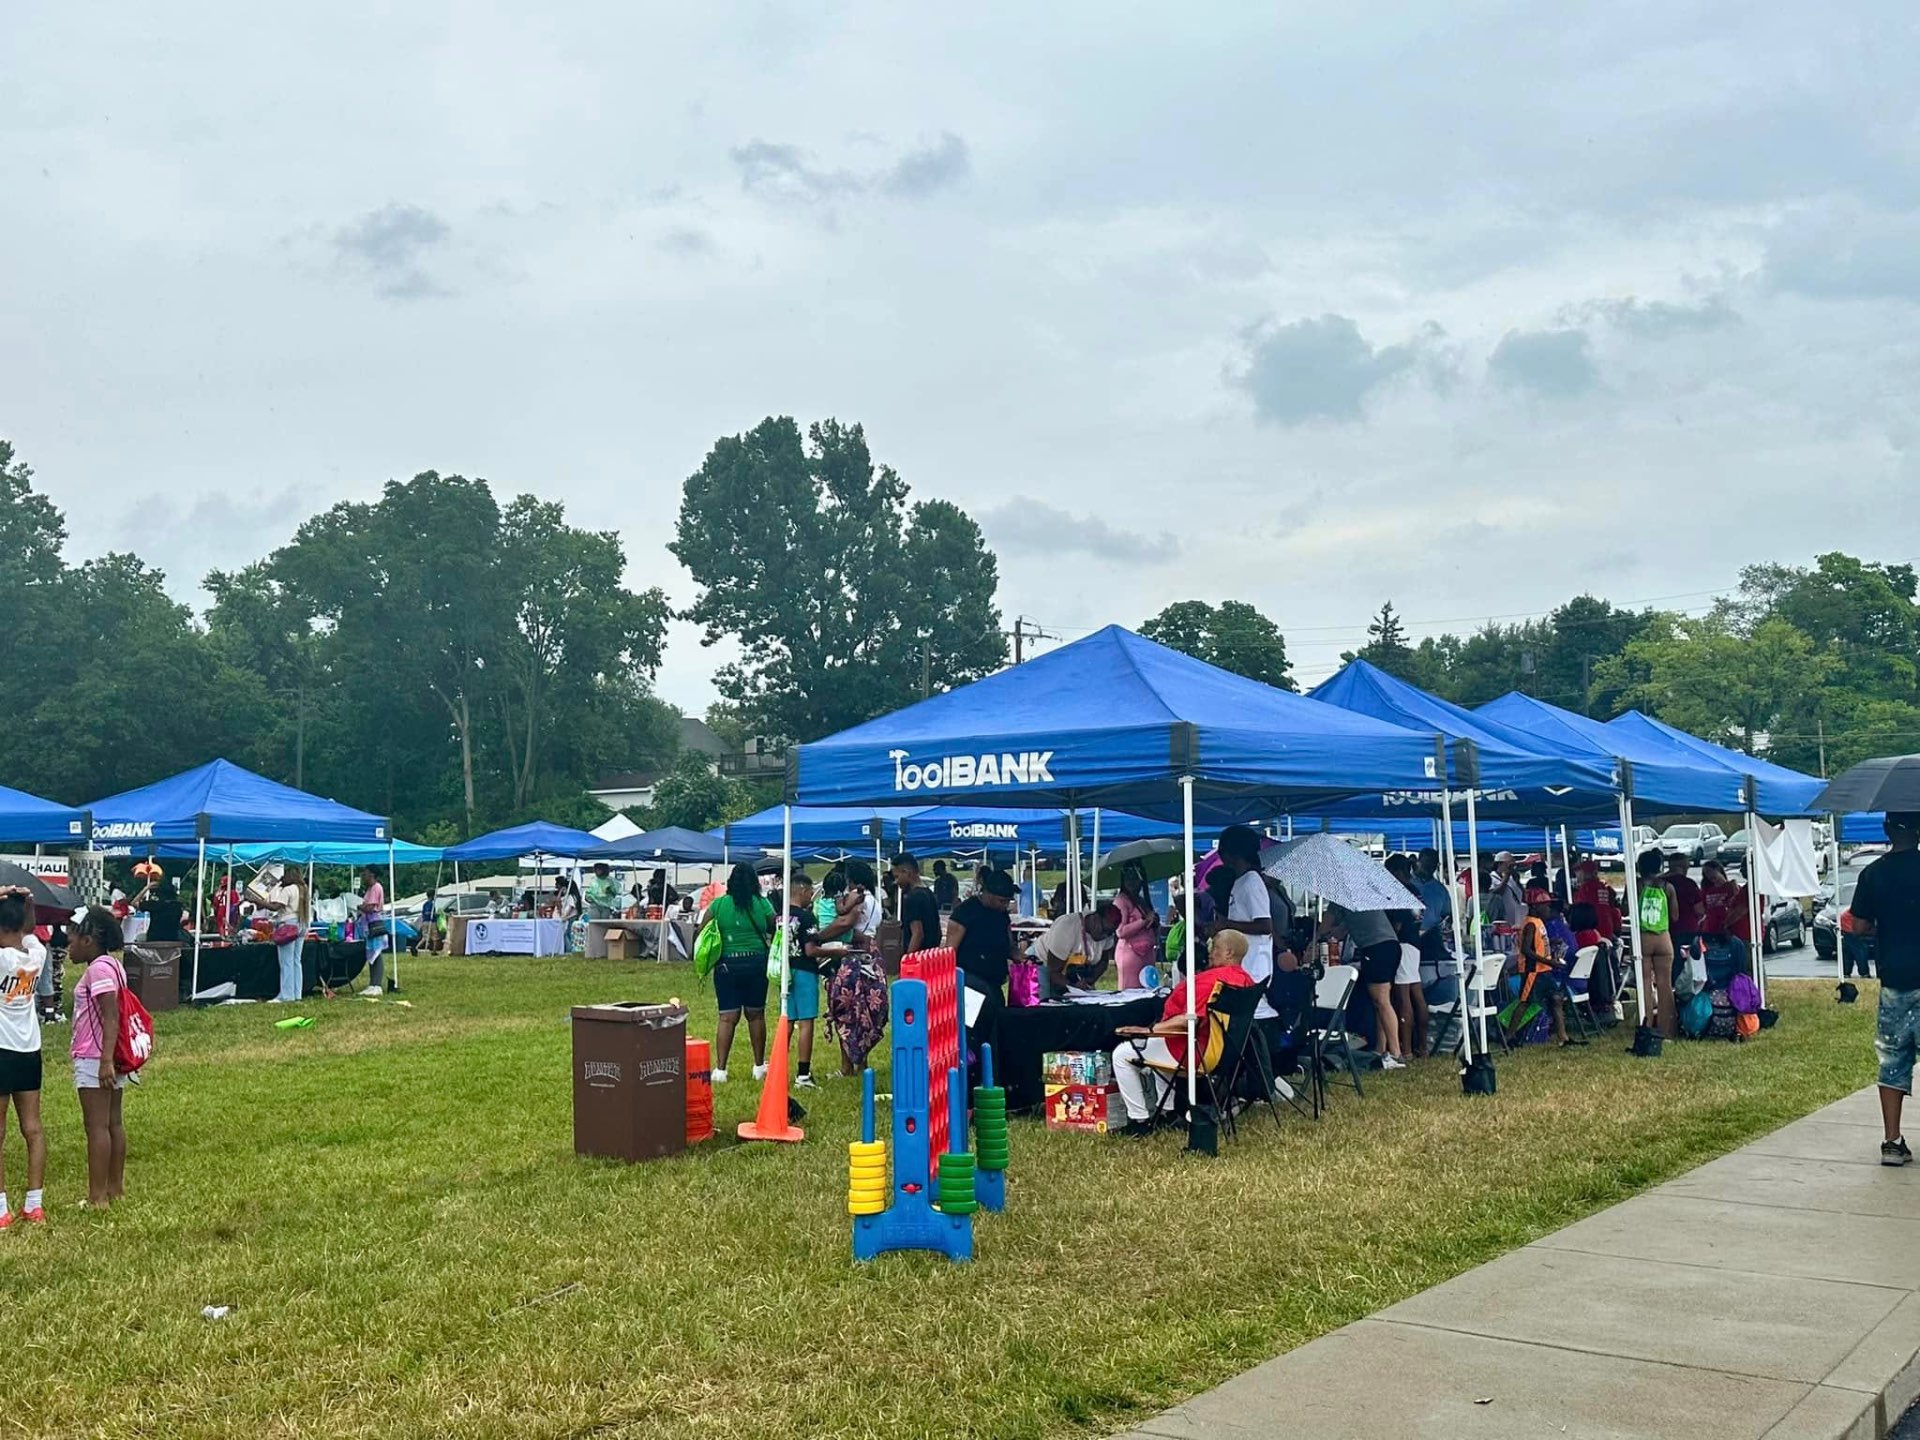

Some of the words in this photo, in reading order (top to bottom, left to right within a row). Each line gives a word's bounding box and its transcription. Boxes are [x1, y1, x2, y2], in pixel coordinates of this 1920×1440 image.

[888, 749, 1055, 791] ToolBANK
[92, 820, 155, 838] oolBANK
[948, 820, 1019, 838] ToolBANK
